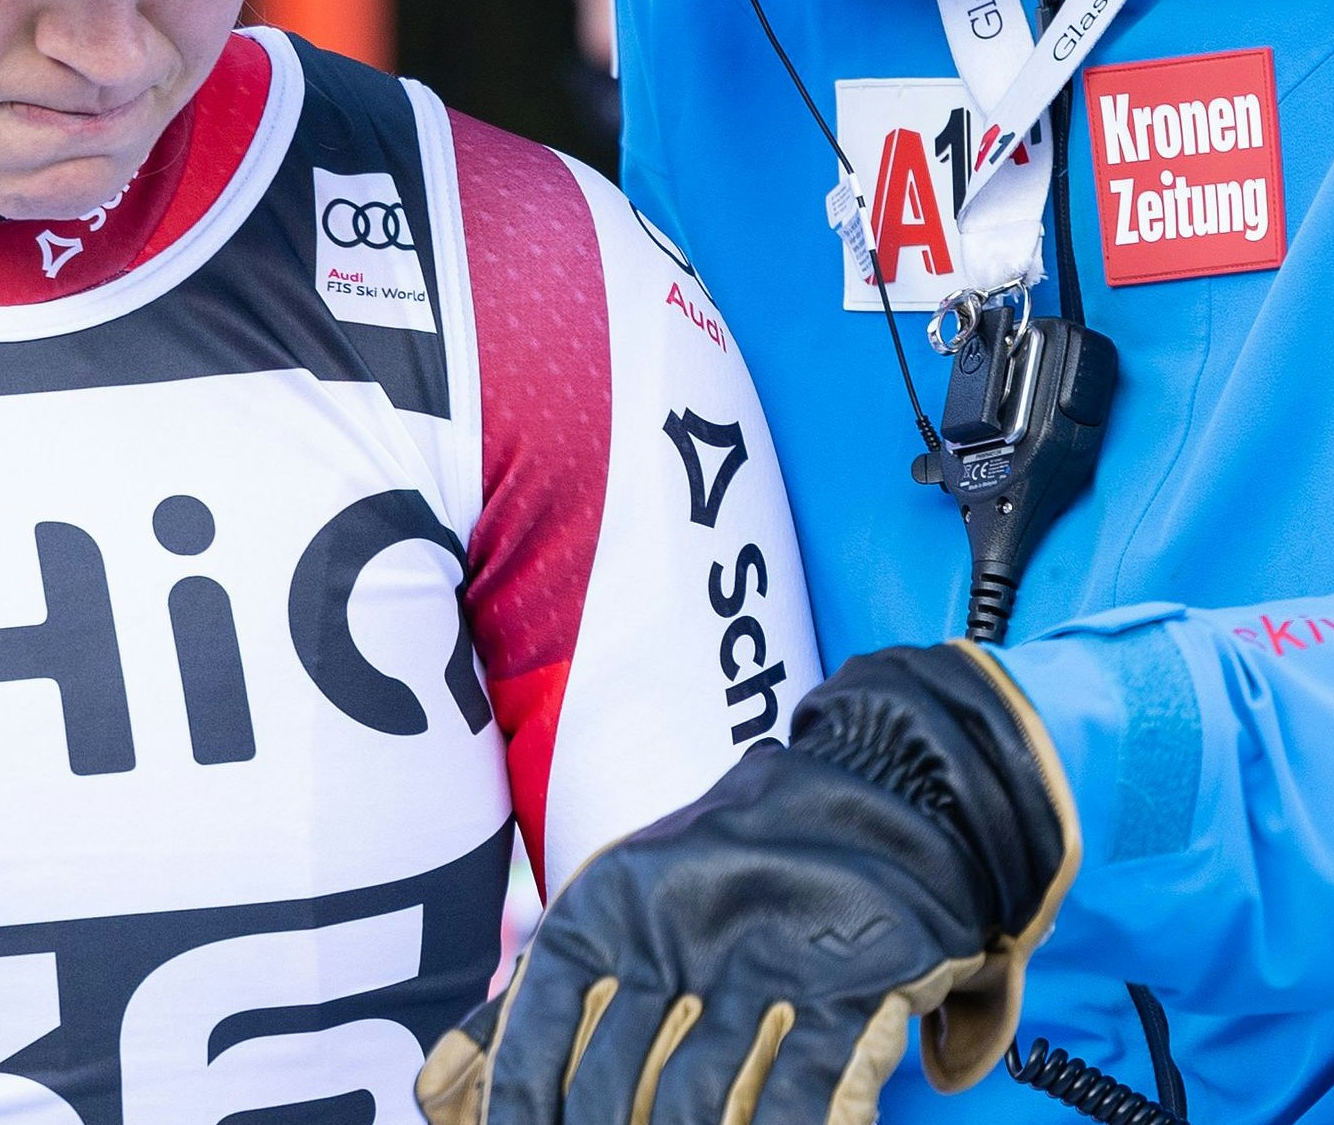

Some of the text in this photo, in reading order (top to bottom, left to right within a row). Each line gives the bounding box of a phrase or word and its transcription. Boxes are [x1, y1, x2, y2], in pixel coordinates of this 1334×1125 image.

[1099, 92, 1263, 165] Kronen
[1109, 170, 1268, 246] Zeitung
[327, 268, 364, 283] Audi
[327, 281, 426, 302] FIS Ski World
[665, 281, 728, 353] Audi
[708, 543, 788, 751] Sch
